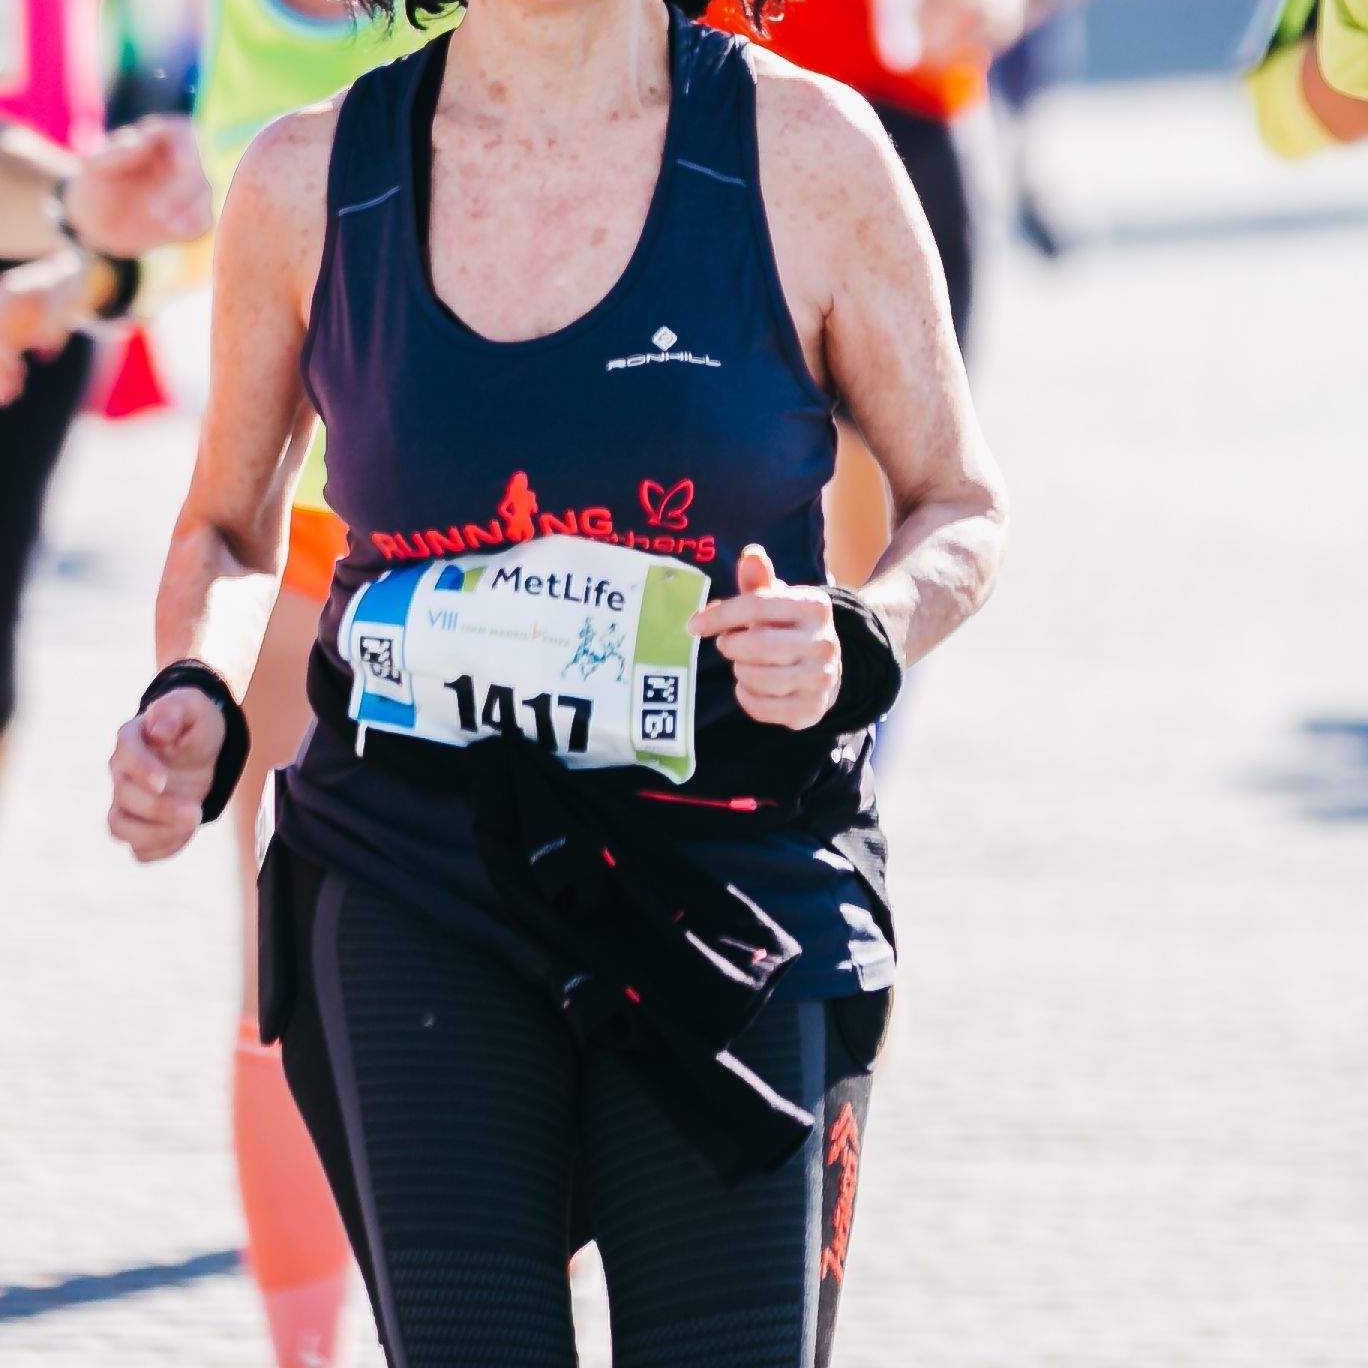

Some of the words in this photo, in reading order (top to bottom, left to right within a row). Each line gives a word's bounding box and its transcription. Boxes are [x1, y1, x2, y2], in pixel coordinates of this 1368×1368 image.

[491, 566, 627, 612] MetLife
[427, 609, 460, 633] VIII
[443, 673, 594, 754] 1417
